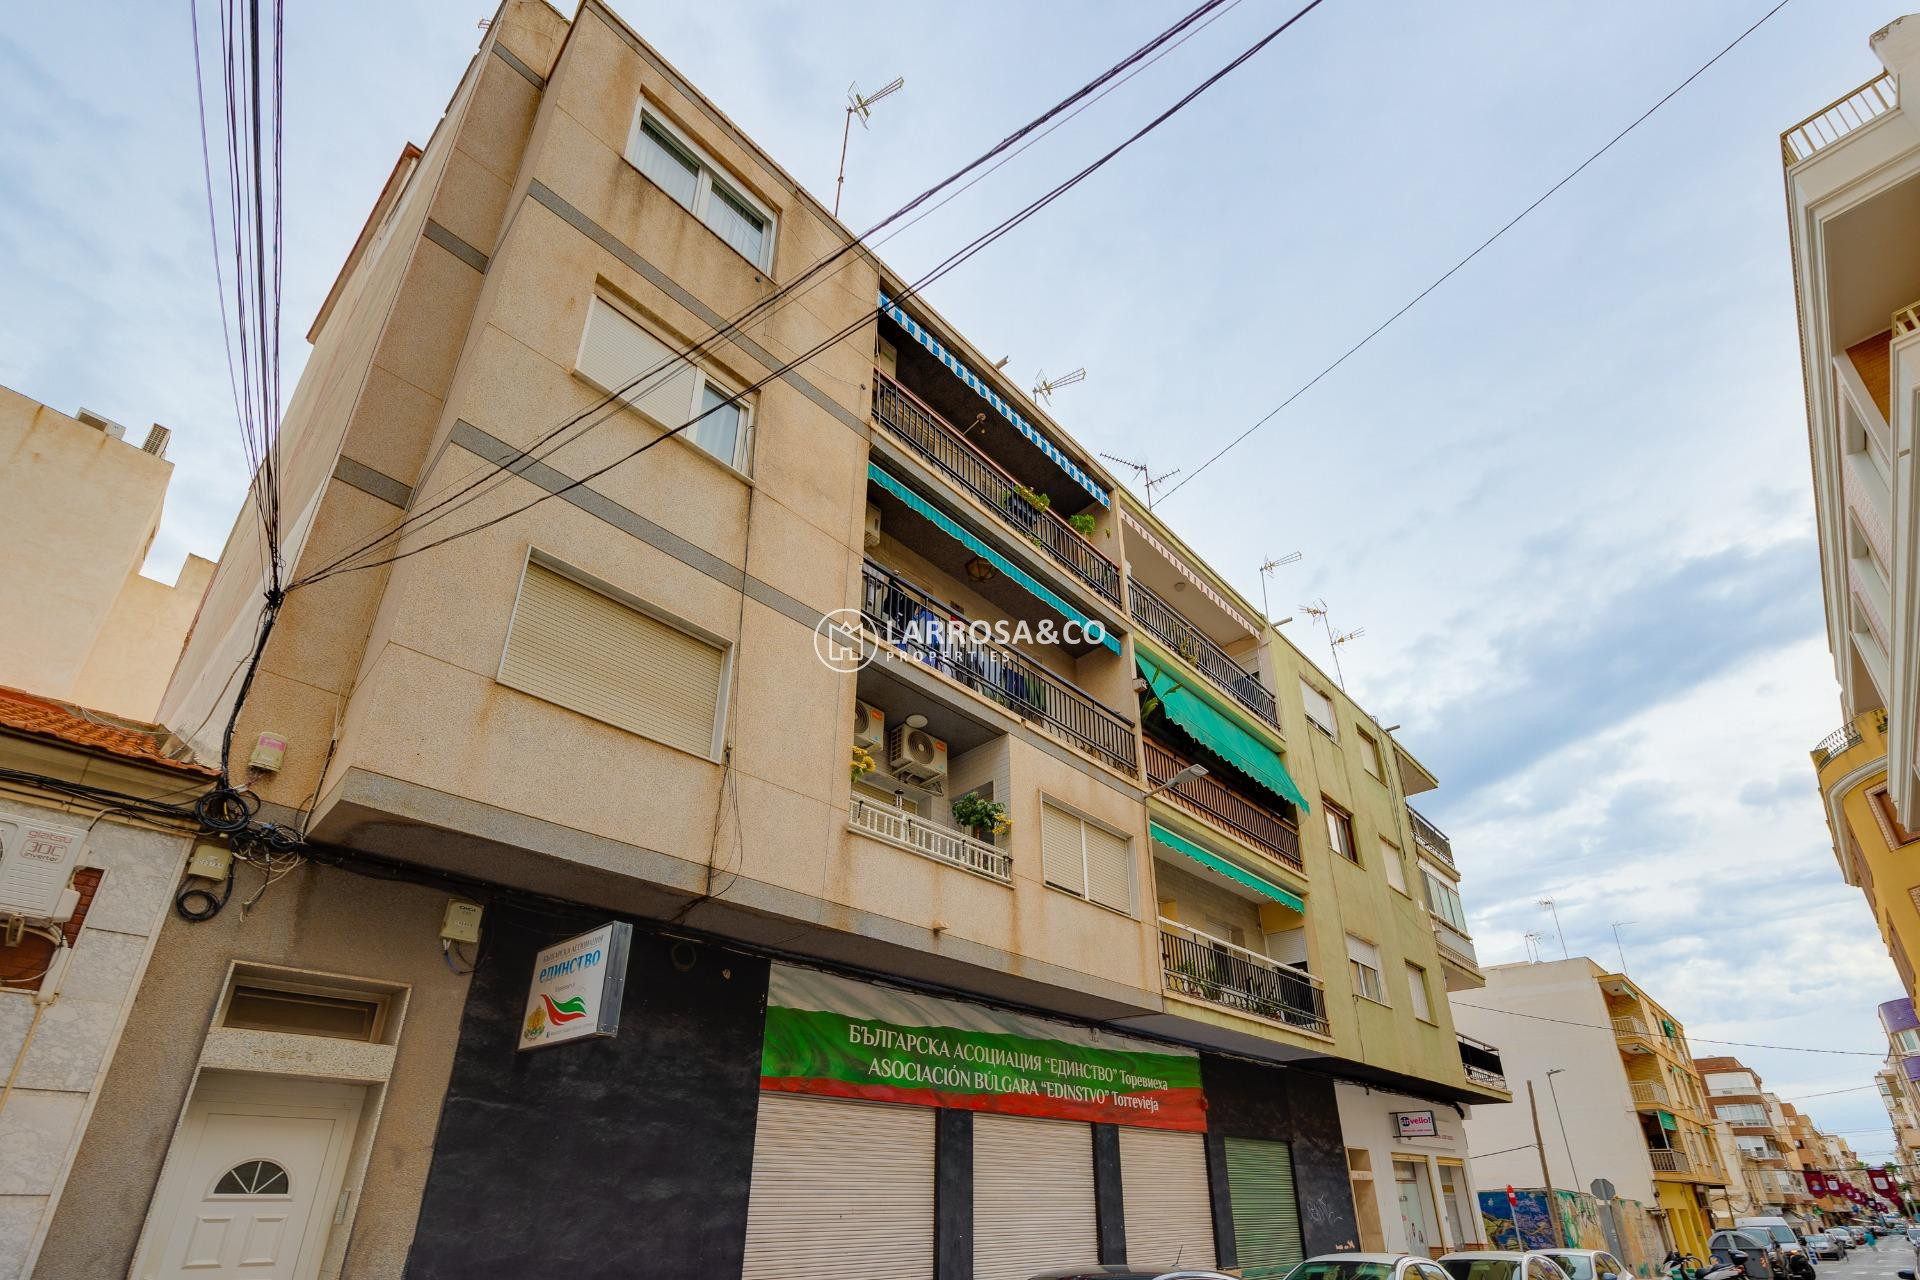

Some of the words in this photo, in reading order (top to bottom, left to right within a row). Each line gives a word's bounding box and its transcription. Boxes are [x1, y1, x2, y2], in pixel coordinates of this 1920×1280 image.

[27, 830, 73, 843] giatsu
[23, 851, 58, 862] inverter
[849, 1024, 951, 1058] БЪЛГАРСКА
[953, 1042, 1042, 1073] АСОЦИАЦИЯ
[1044, 1057, 1117, 1082] “ЕДИНСТВО”
[1119, 1069, 1168, 1091] Торевиеха
[868, 1057, 970, 1088] ASOCIACIÓN
[974, 1070, 1039, 1096] BÚLGARA
[1041, 1081, 1109, 1104] “EDINSTVO”
[1111, 1091, 1159, 1113] Torrevieja
